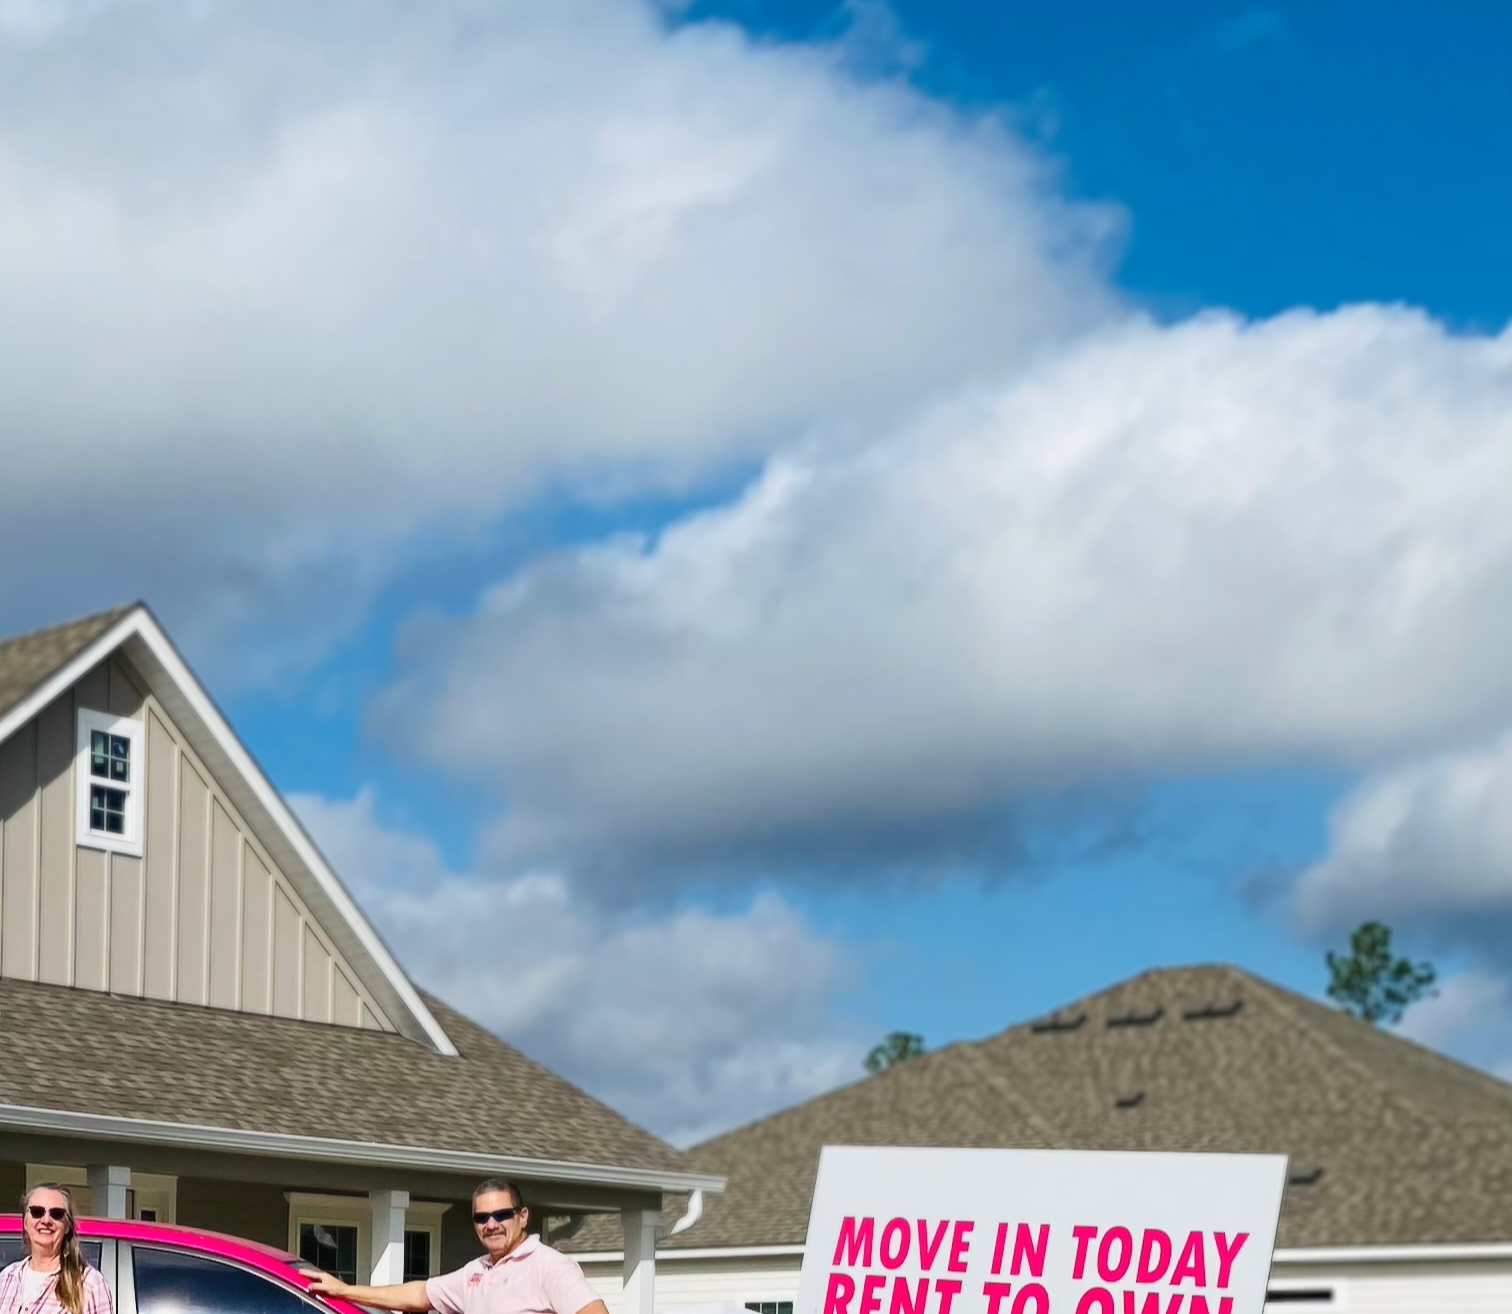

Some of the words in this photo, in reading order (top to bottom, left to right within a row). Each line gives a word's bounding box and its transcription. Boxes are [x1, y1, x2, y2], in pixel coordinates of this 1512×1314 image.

[832, 1216, 975, 1273] MOVE
[990, 1222, 1051, 1277] IN
[1071, 1225, 1251, 1289] TODAY
